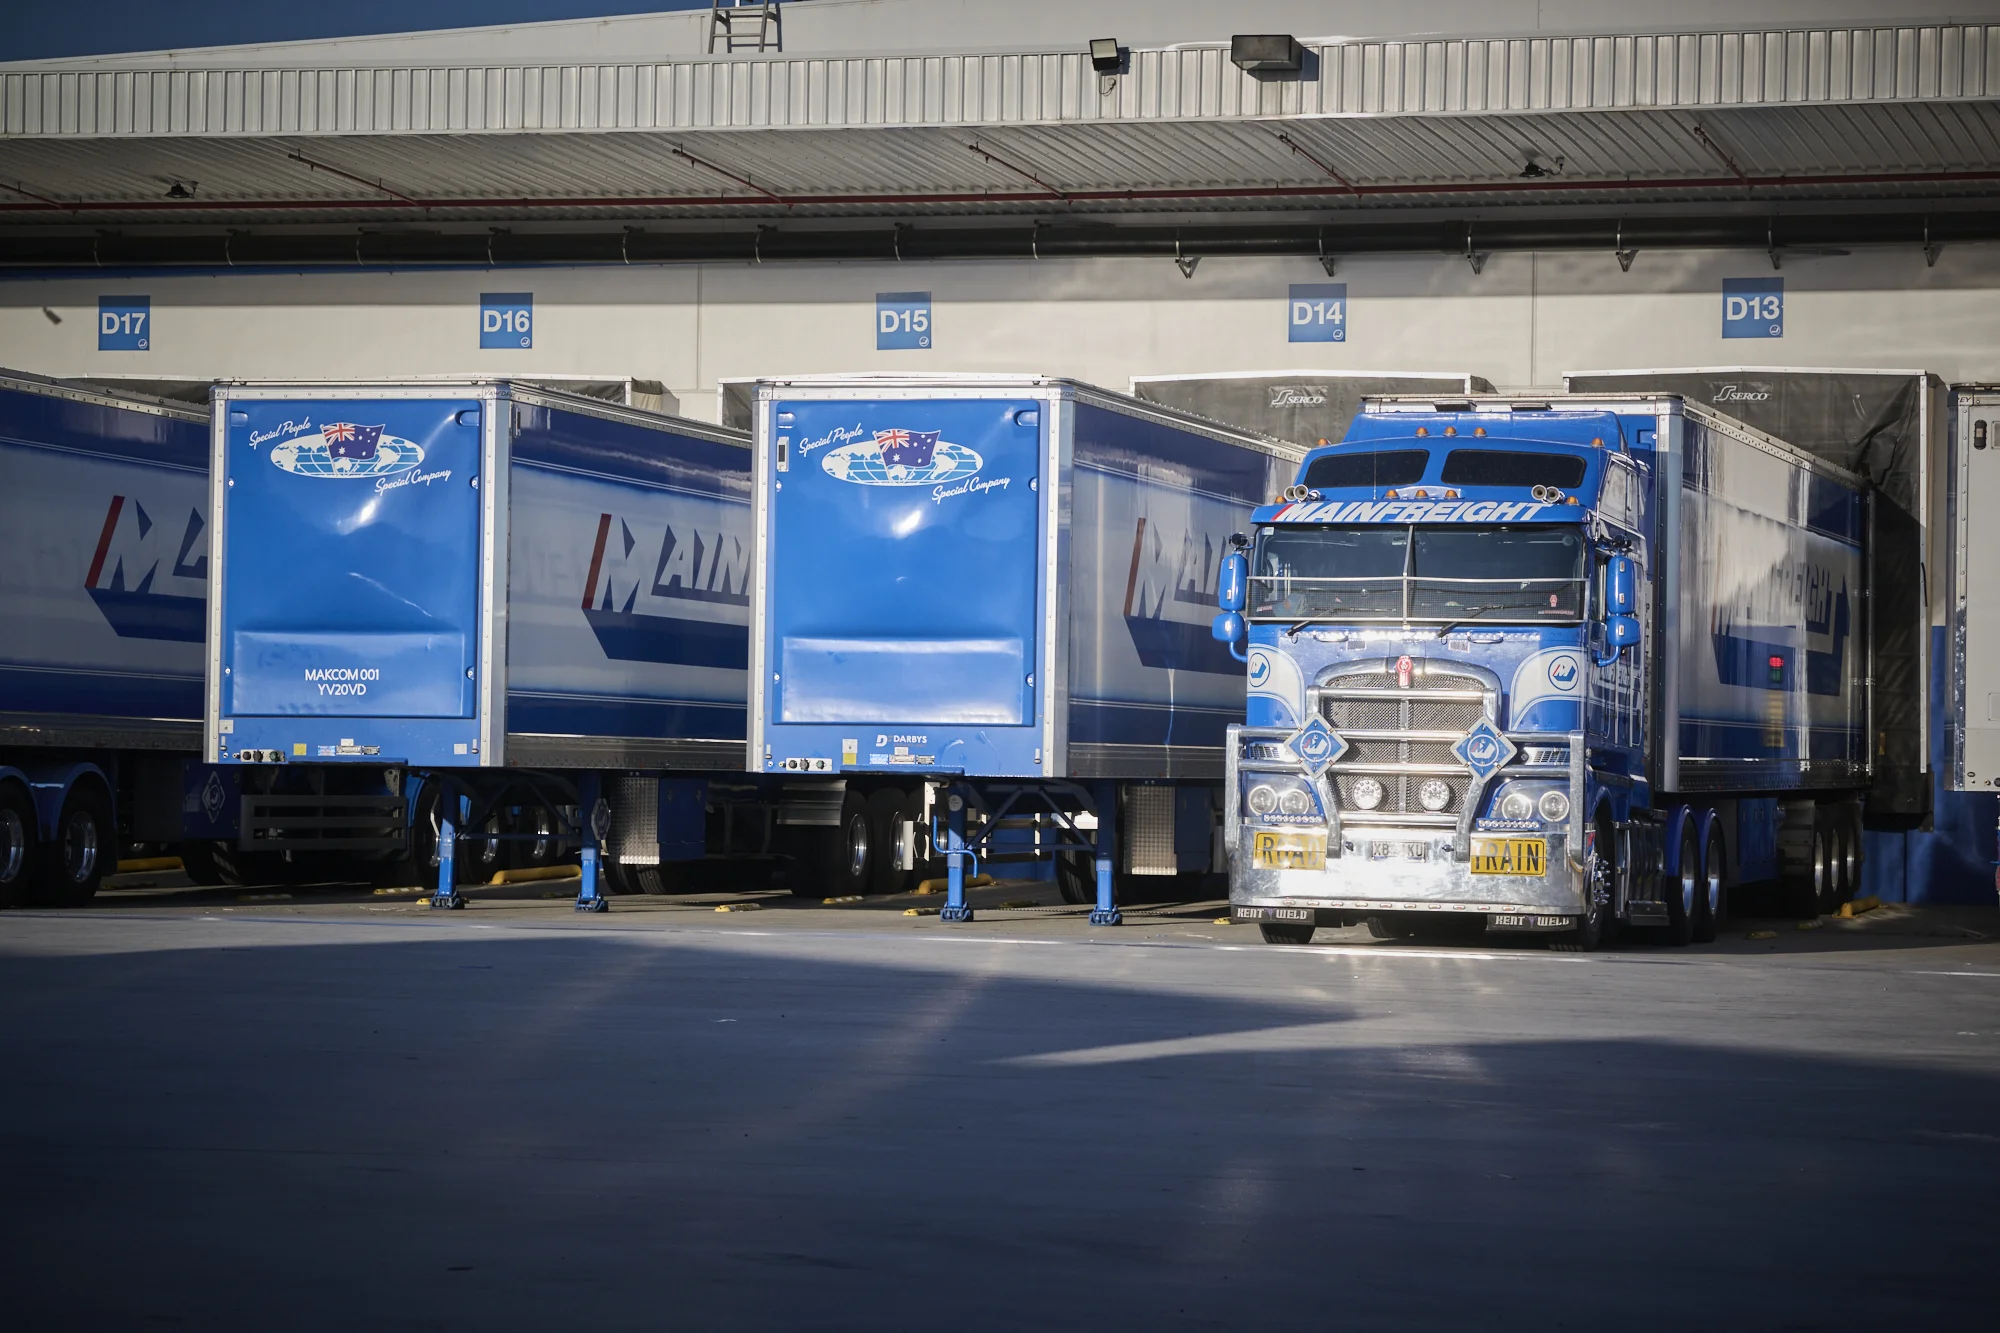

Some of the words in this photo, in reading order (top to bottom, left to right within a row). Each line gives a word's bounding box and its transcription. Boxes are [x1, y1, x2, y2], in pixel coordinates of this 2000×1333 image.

[1293, 301, 1343, 325] D14
[1726, 295, 1780, 320] D13
[101, 312, 146, 334] D17
[483, 310, 530, 333] D16
[880, 309, 929, 333] D15
[249, 424, 282, 449] Special
[281, 416, 311, 437] People
[799, 431, 832, 457] Special
[832, 423, 863, 444] People
[374, 471, 410, 496] Special
[409, 468, 451, 486] Company
[931, 480, 968, 504] Special
[968, 476, 1010, 495] Company
[1272, 501, 1553, 522] MAINFREIGHT
[305, 668, 359, 681] MAKCOM
[360, 668, 380, 681] 001
[317, 683, 367, 696] YV20VD
[893, 735, 927, 743] DARBYS
[1262, 836, 1321, 866] ROAD
[1473, 841, 1539, 872] TRAIN
[1237, 907, 1264, 918] KENT
[1275, 908, 1307, 919] WELD
[1495, 915, 1526, 926] KENT
[1537, 916, 1570, 926] WELD
